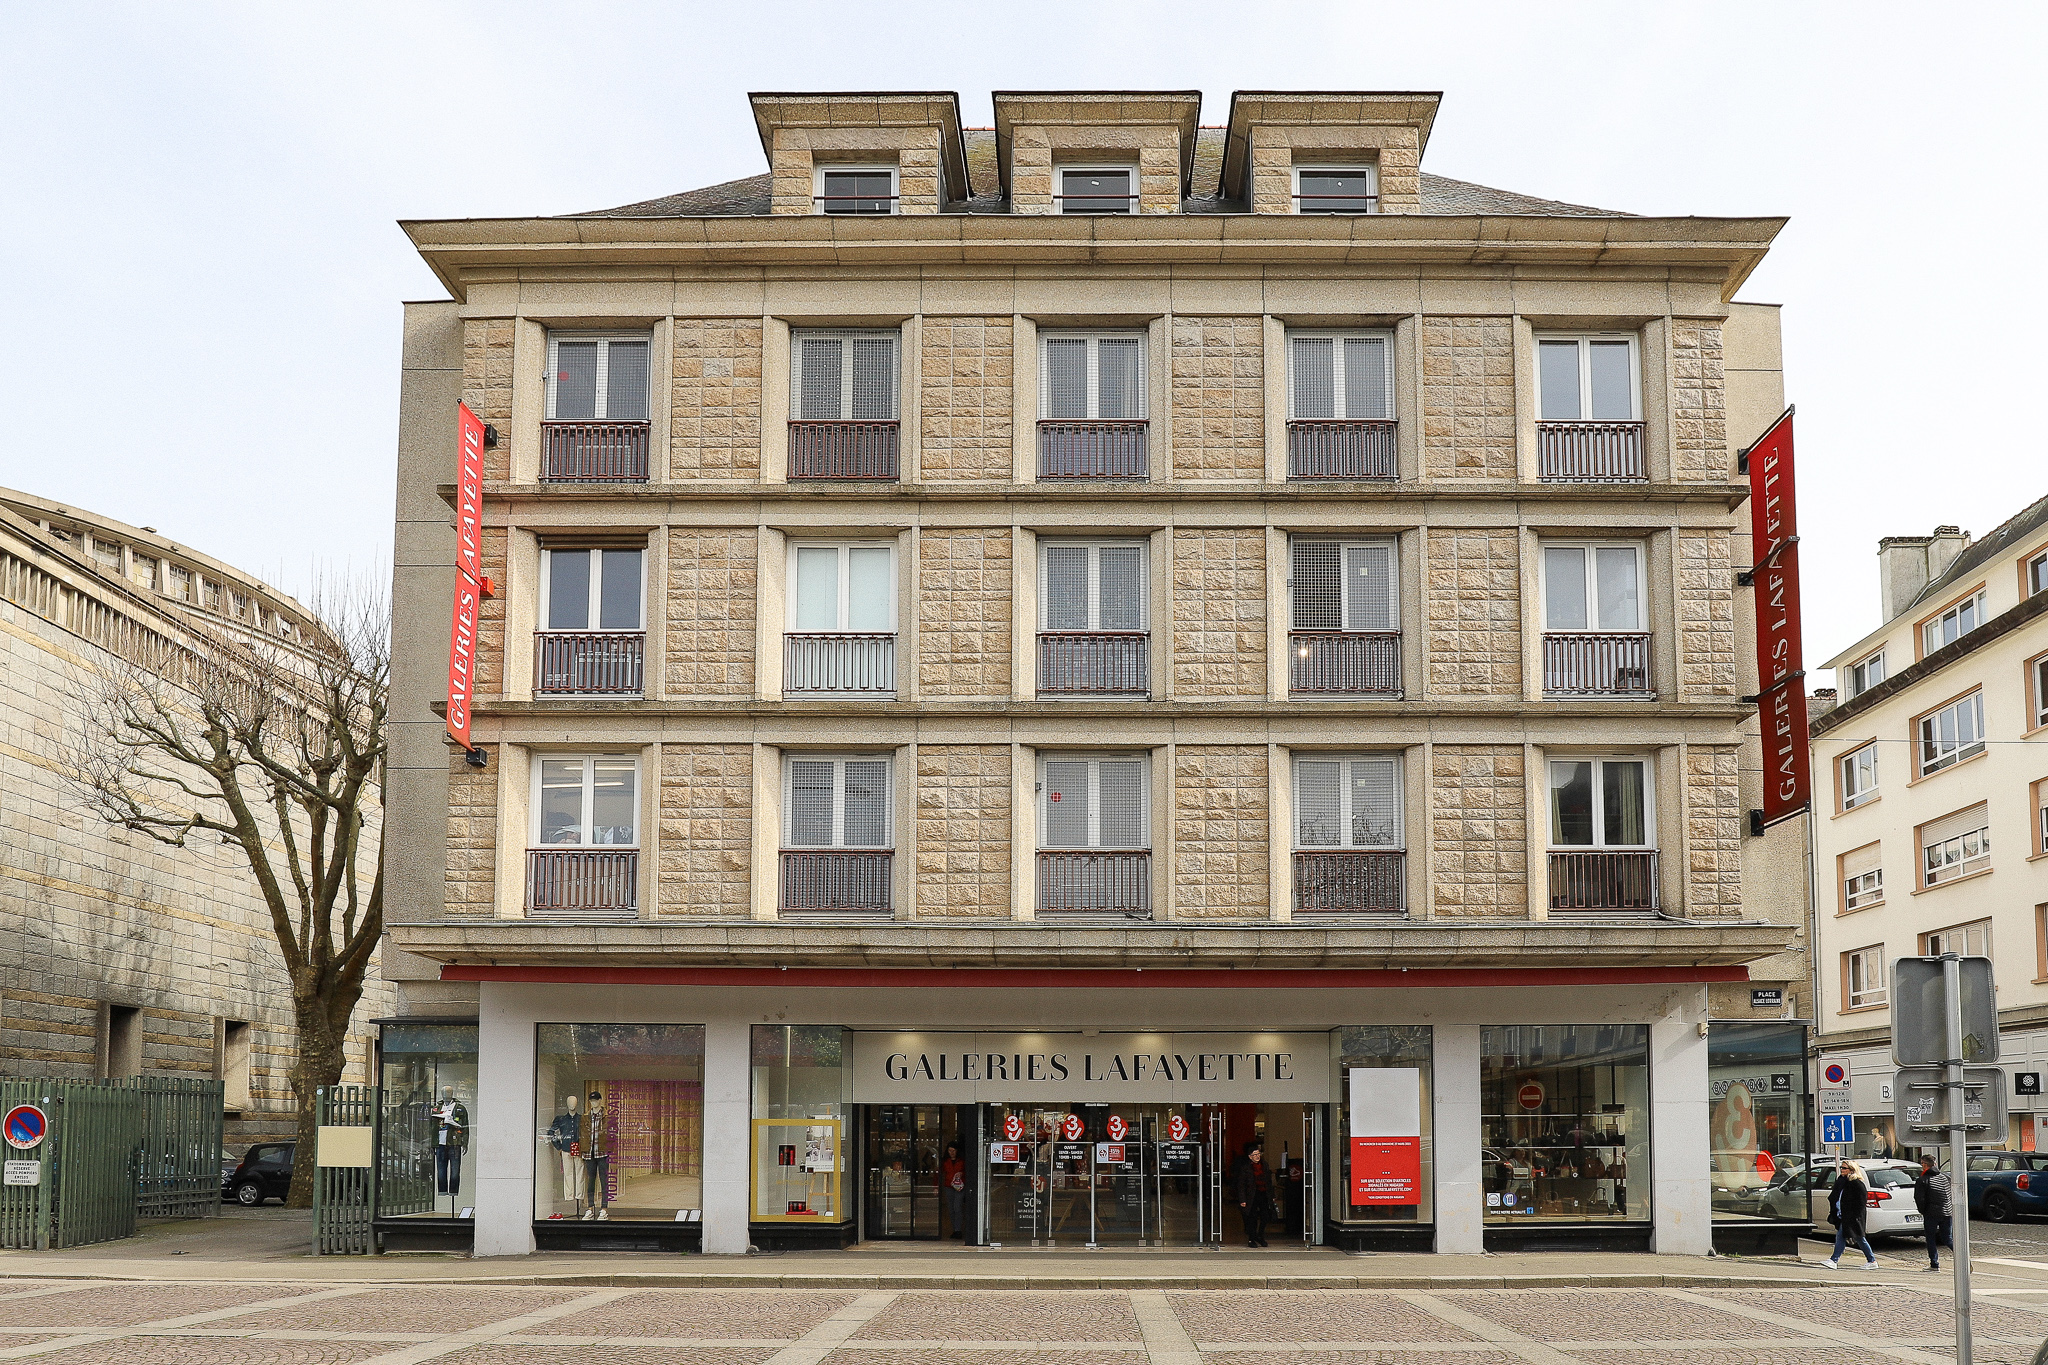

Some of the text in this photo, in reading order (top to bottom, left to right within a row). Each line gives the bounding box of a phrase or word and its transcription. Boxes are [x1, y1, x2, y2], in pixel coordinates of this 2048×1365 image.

[450, 424, 479, 730] GALERIES LAFAYETTE
[1764, 446, 1787, 632] LAFAYETTE
[885, 1053, 1295, 1082] GALERIES LAFAYETTE
[606, 1168, 618, 1202] MODE
